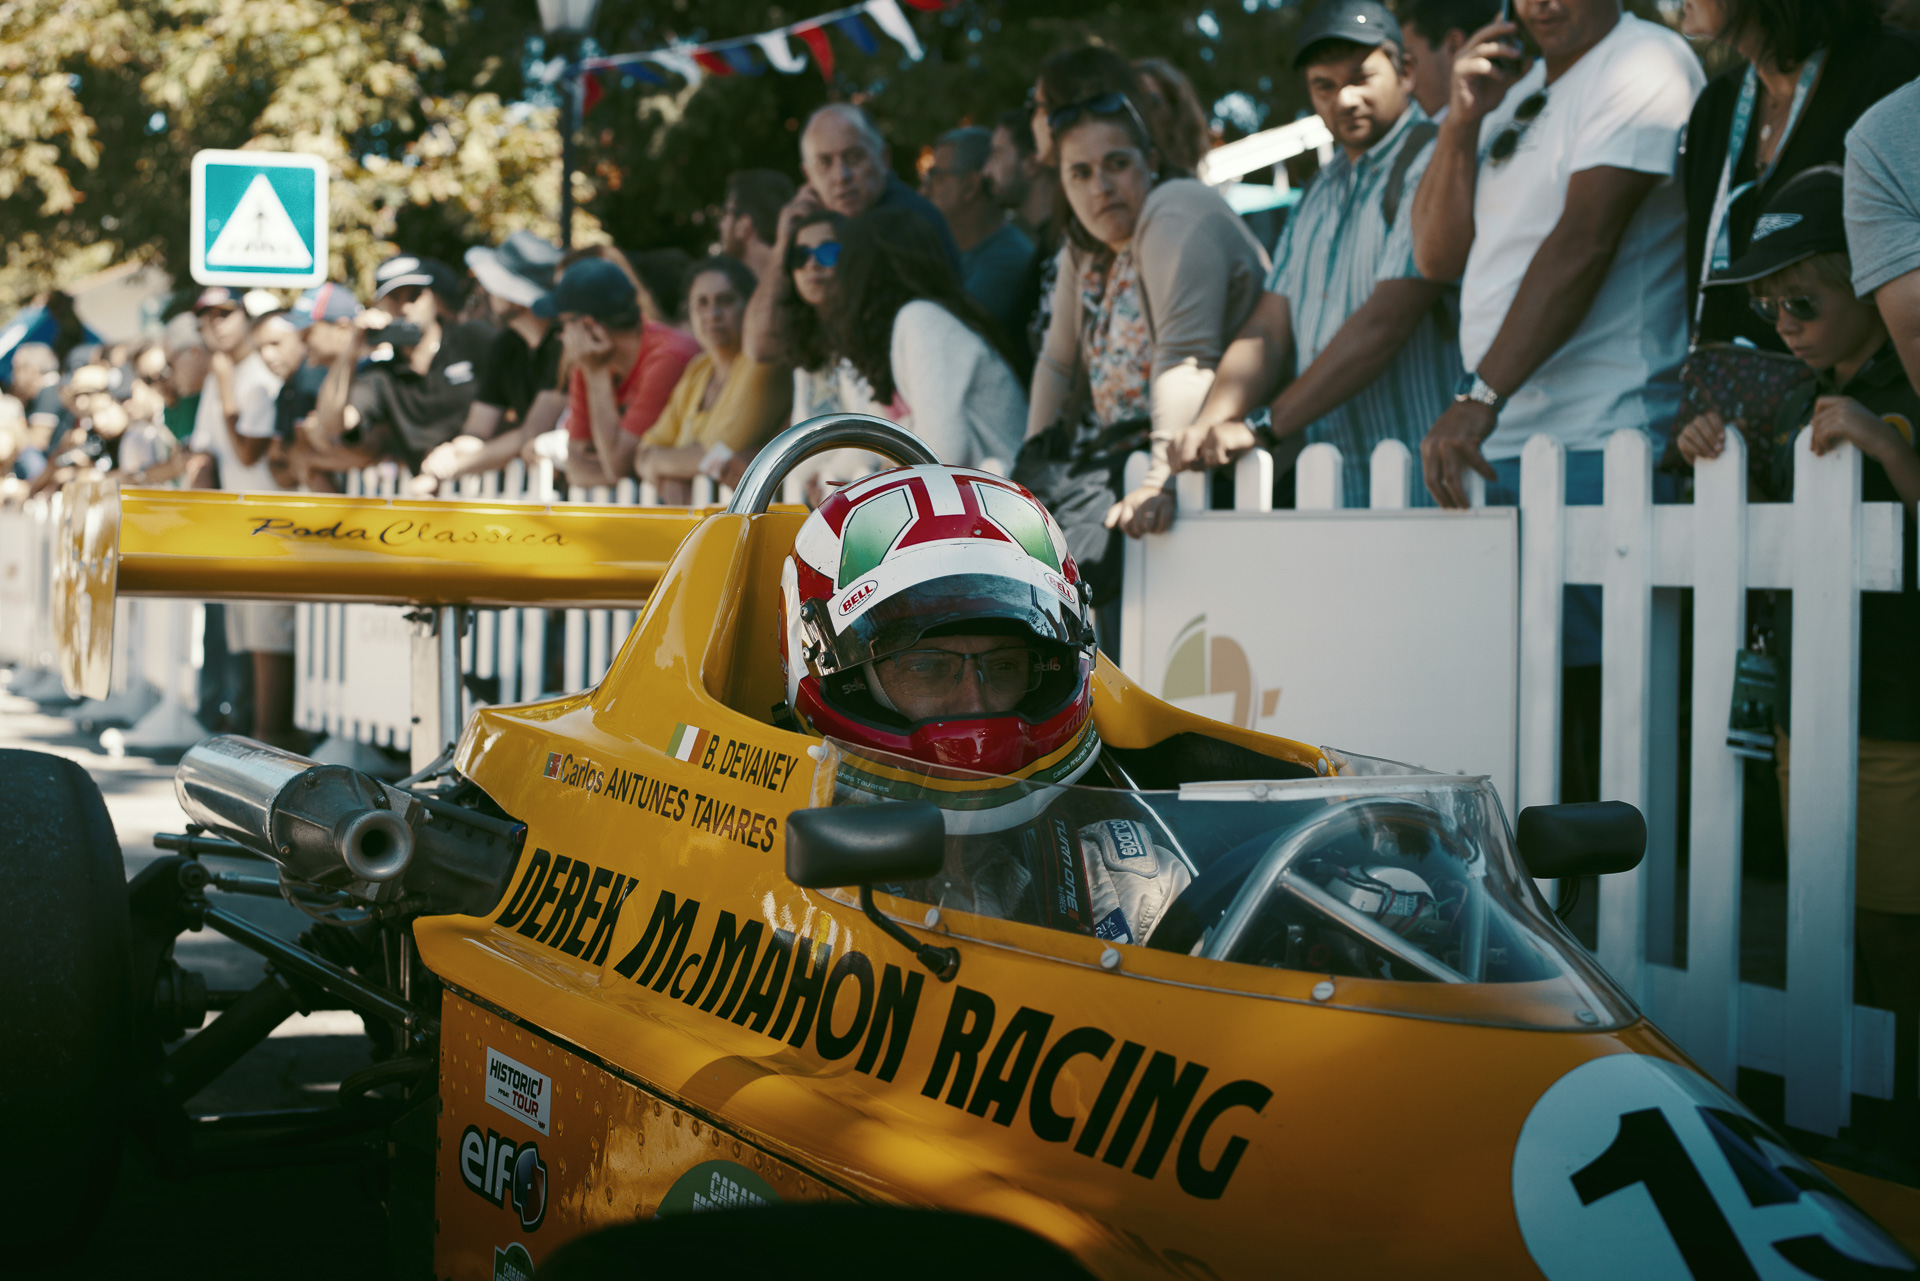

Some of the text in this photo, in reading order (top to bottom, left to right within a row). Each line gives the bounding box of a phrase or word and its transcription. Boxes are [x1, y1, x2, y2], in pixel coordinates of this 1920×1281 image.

[248, 517, 572, 547] Roda Classica
[842, 584, 874, 613] BELL
[1048, 576, 1073, 601] BELL
[701, 734, 799, 794] B. DEVANEY
[856, 777, 890, 793] Tavares
[560, 753, 778, 853] Carlos ANTUNES TAVARES
[1064, 866, 1079, 913] ONE
[494, 848, 1275, 1200] DEREK McMAHON RACING
[489, 1057, 539, 1100] HISTORIC
[512, 1090, 539, 1118] TOUR
[461, 1129, 515, 1203] elf
